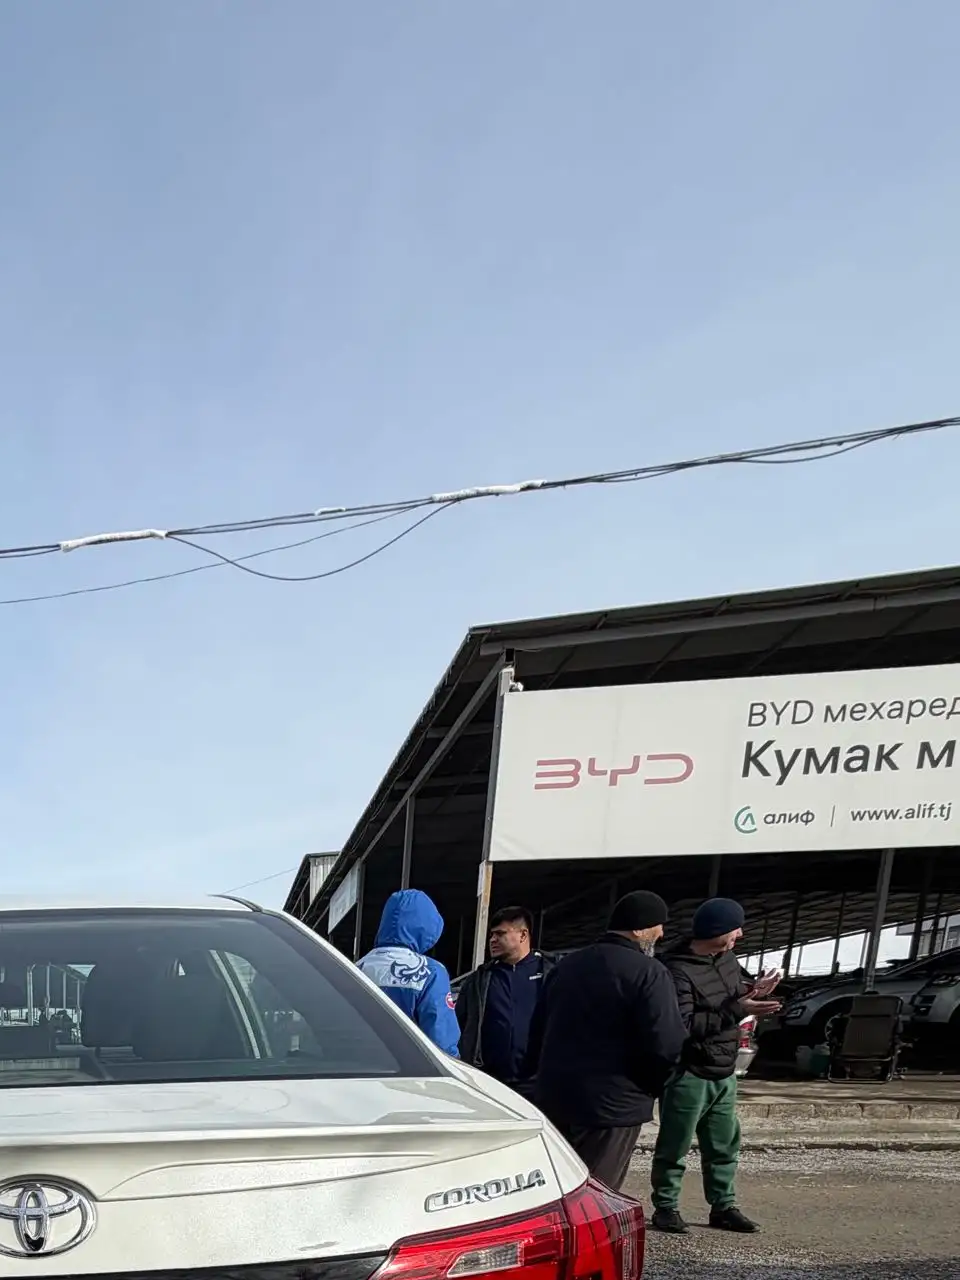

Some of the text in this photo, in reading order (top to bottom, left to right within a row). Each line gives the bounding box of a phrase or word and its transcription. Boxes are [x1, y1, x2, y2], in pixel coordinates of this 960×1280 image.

[747, 699, 814, 727] BYD
[534, 753, 694, 790] BYD
[741, 739, 904, 786] Кумак
[763, 802, 953, 826] алиф www.alif.tj
[424, 1169, 547, 1213] COROLLA
